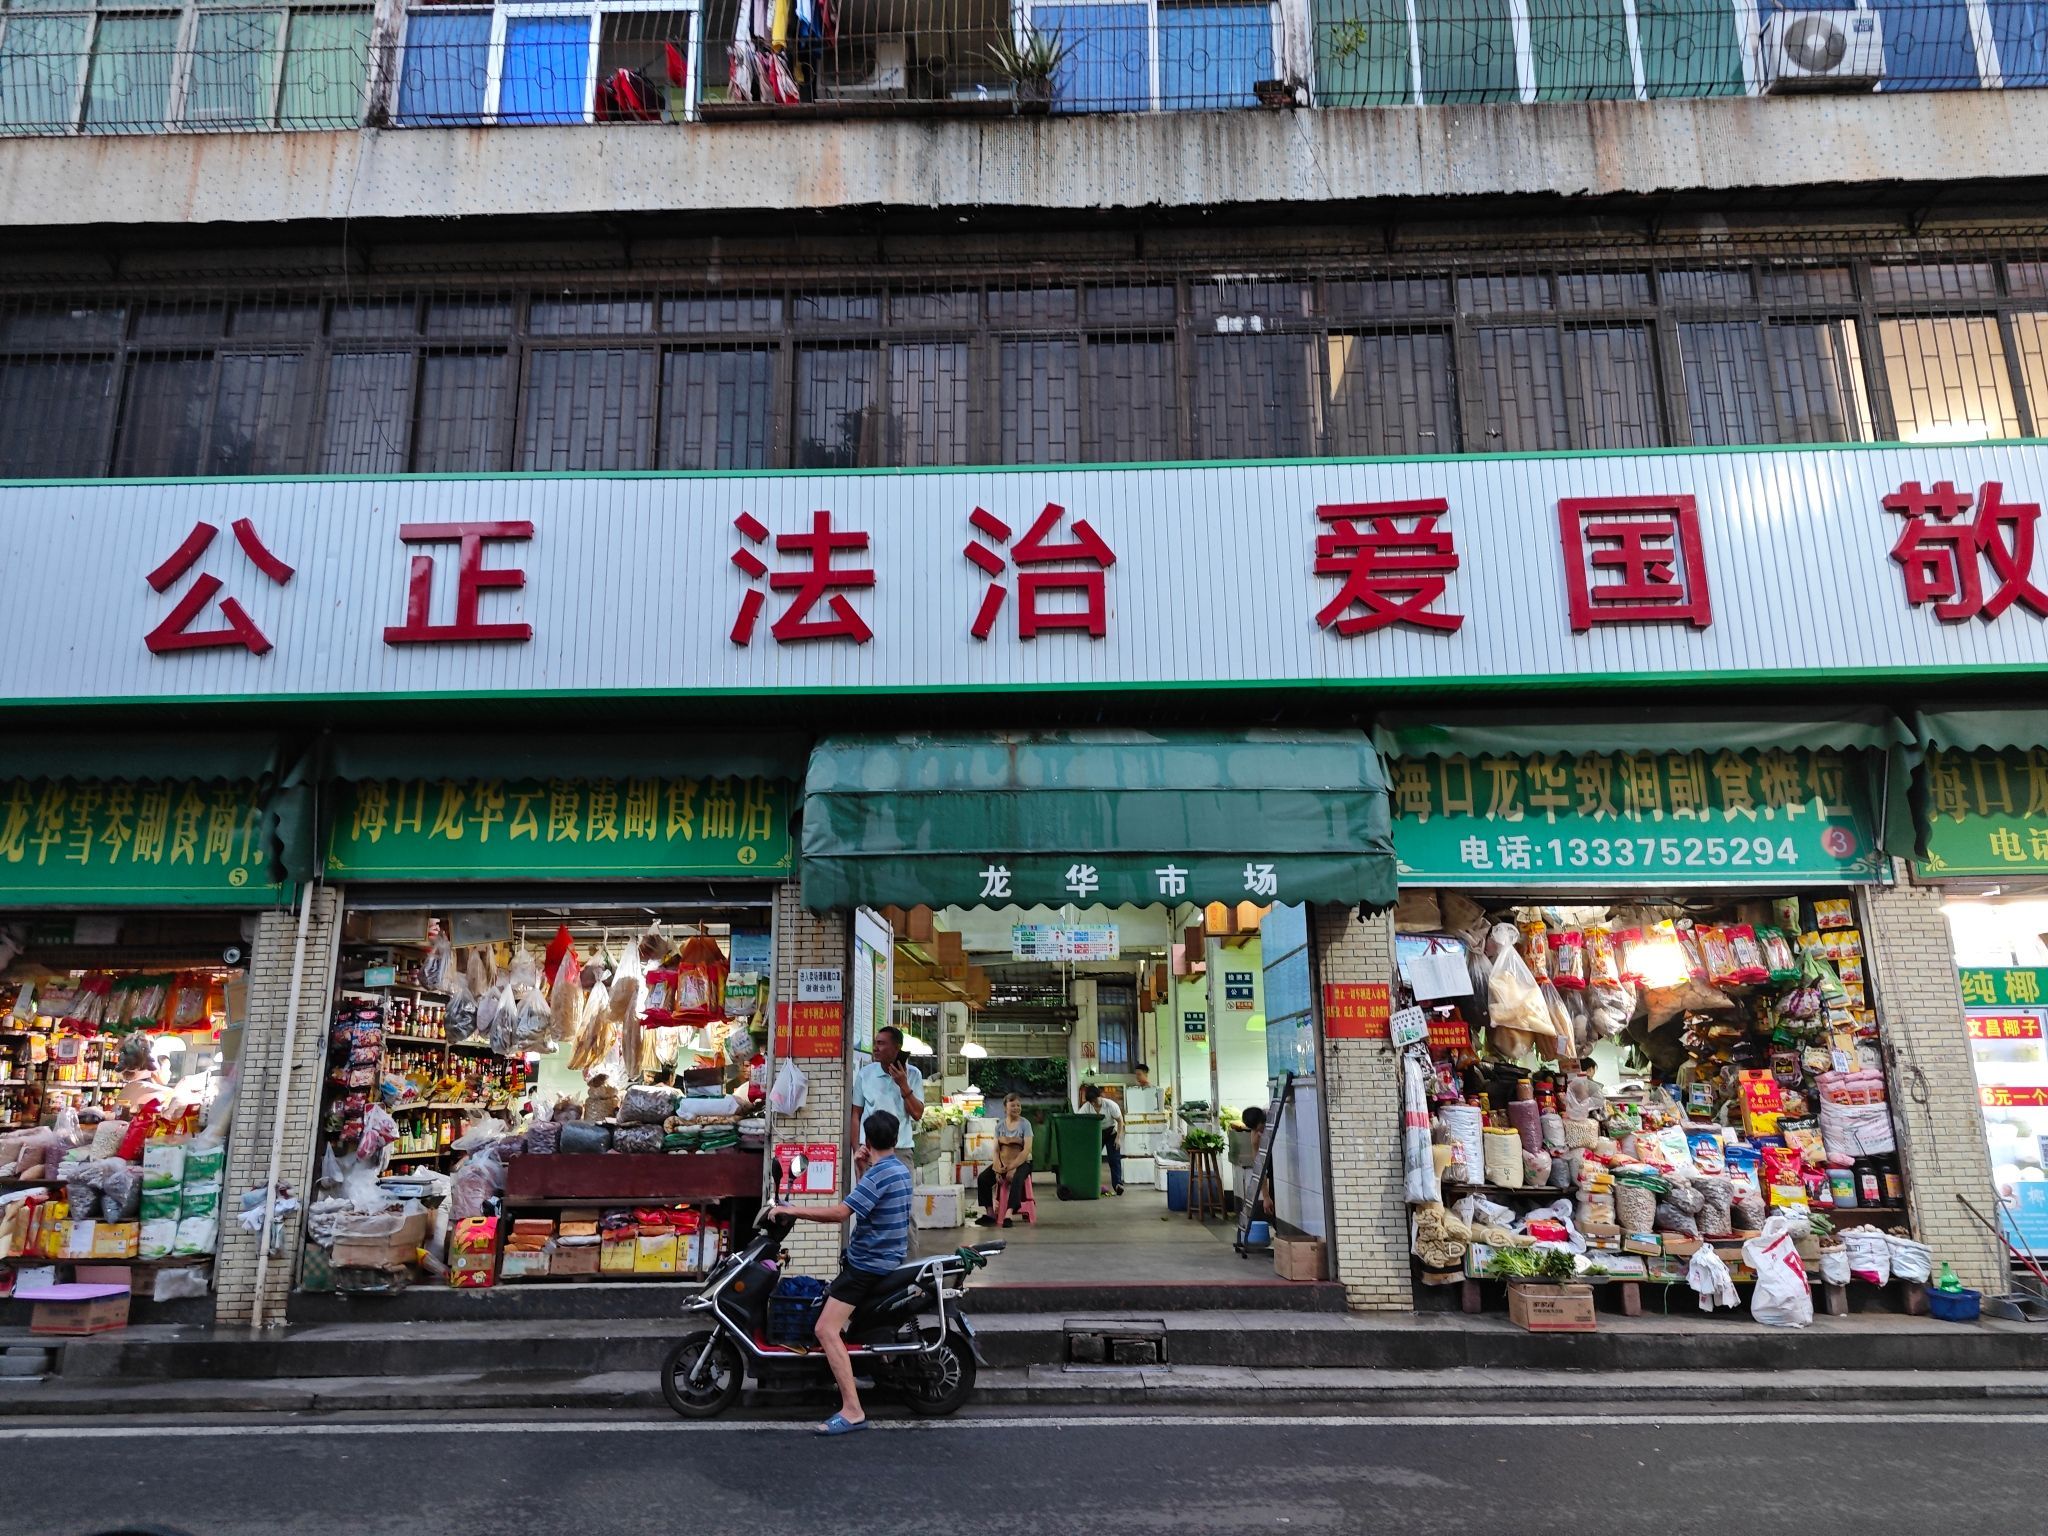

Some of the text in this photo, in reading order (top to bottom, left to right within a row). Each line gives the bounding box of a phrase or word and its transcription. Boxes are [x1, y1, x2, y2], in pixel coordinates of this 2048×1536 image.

[145, 517, 535, 657] 公正
[730, 502, 1117, 647] 法治
[1315, 494, 1713, 637] 爱国
[1459, 834, 1799, 870] 电话:13337525294
[1829, 830, 1849, 854] 3
[979, 861, 1279, 899] 龙华市场
[1962, 970, 2041, 1005] 纯椰
[1967, 1018, 2039, 1039] 文昌椰子
[1980, 1087, 2048, 1106] 6元一个
